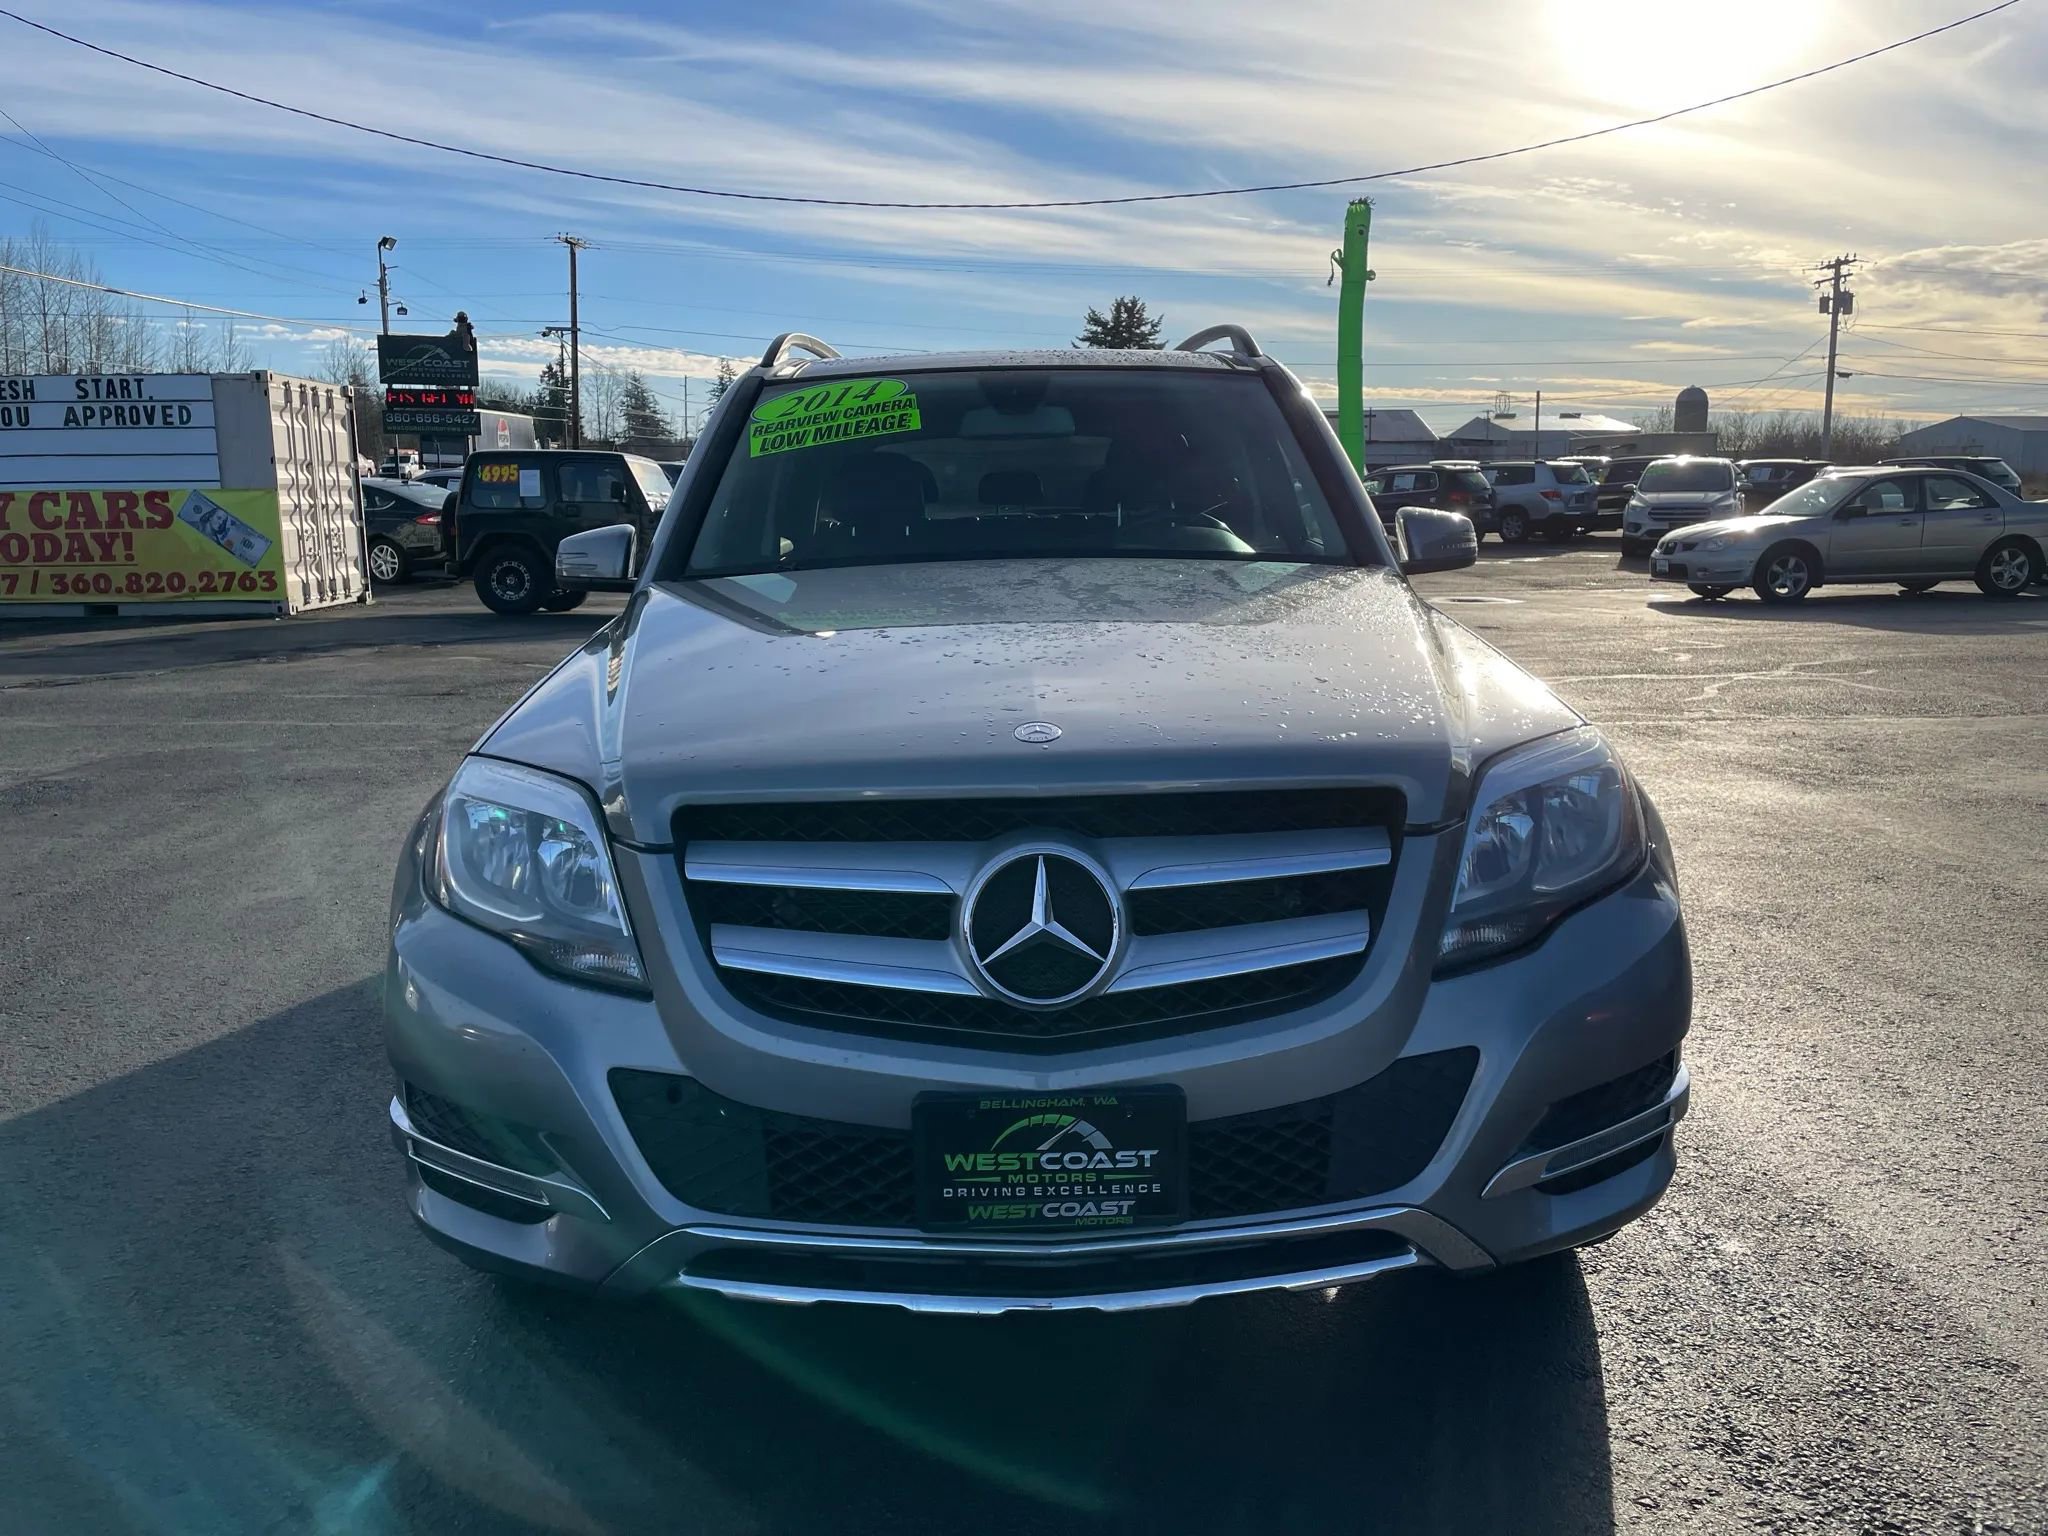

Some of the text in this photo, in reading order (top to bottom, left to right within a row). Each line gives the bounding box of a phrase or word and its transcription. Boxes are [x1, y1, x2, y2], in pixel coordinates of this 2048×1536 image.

[0, 379, 35, 400] ESH
[776, 381, 882, 418] 2014
[1, 405, 192, 427] OU APPROVED
[752, 398, 914, 438] REARVIEW CAMERA
[759, 413, 913, 453] LOW MILEAGE
[28, 490, 174, 531] CARS
[0, 532, 135, 563] ODAY!
[0, 574, 19, 594] 7
[49, 571, 278, 595] 360.820.2763
[1094, 1096, 1119, 1105] WA
[944, 1149, 1160, 1172] WESTCOAST
[1008, 1172, 1097, 1184] MOTORS
[944, 1183, 1161, 1198] DRIVING EXCELLENCE
[967, 1200, 1136, 1220] WESTCOAST
[1075, 1216, 1133, 1225] MOTORS
